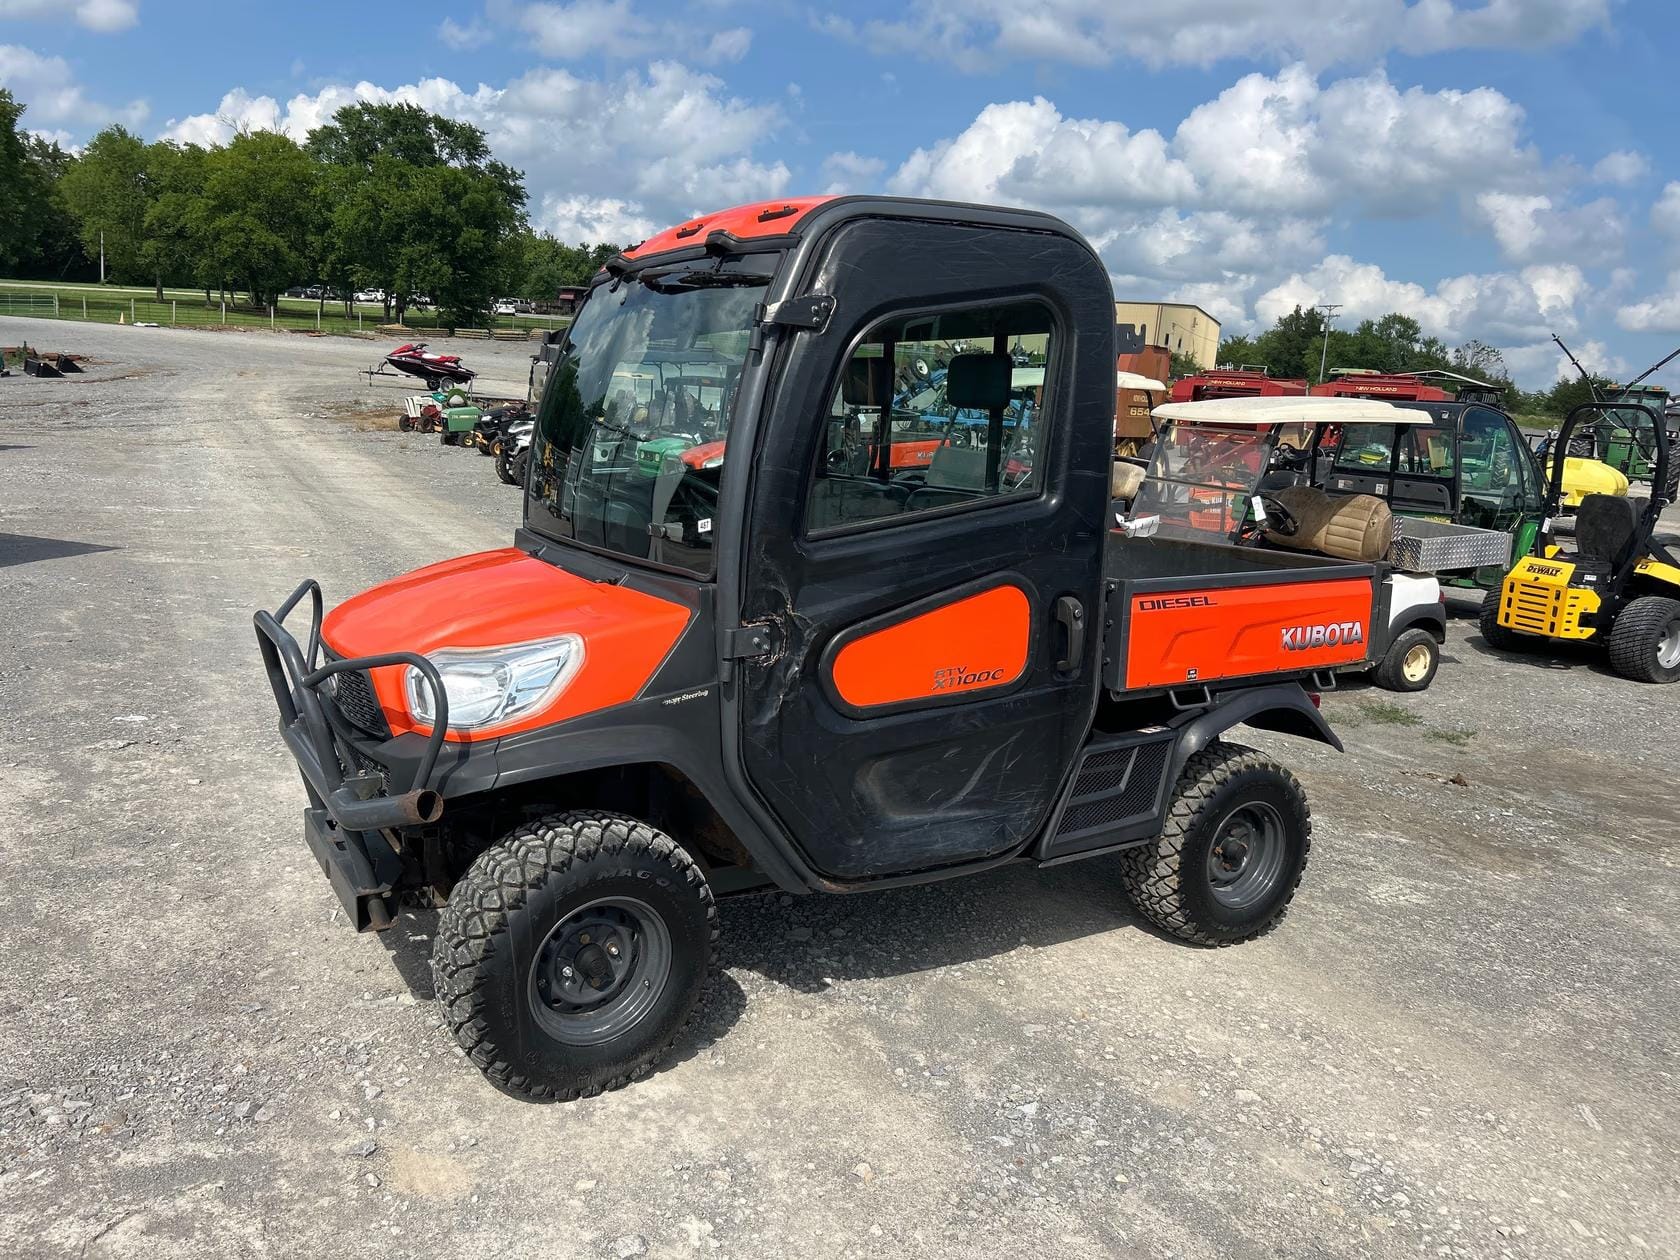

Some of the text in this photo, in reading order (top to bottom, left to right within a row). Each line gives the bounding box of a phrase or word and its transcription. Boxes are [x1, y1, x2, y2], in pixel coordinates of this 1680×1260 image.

[1139, 596, 1218, 611] DIESEL
[1281, 620, 1364, 651] KUBOTA
[934, 666, 967, 679] RTV
